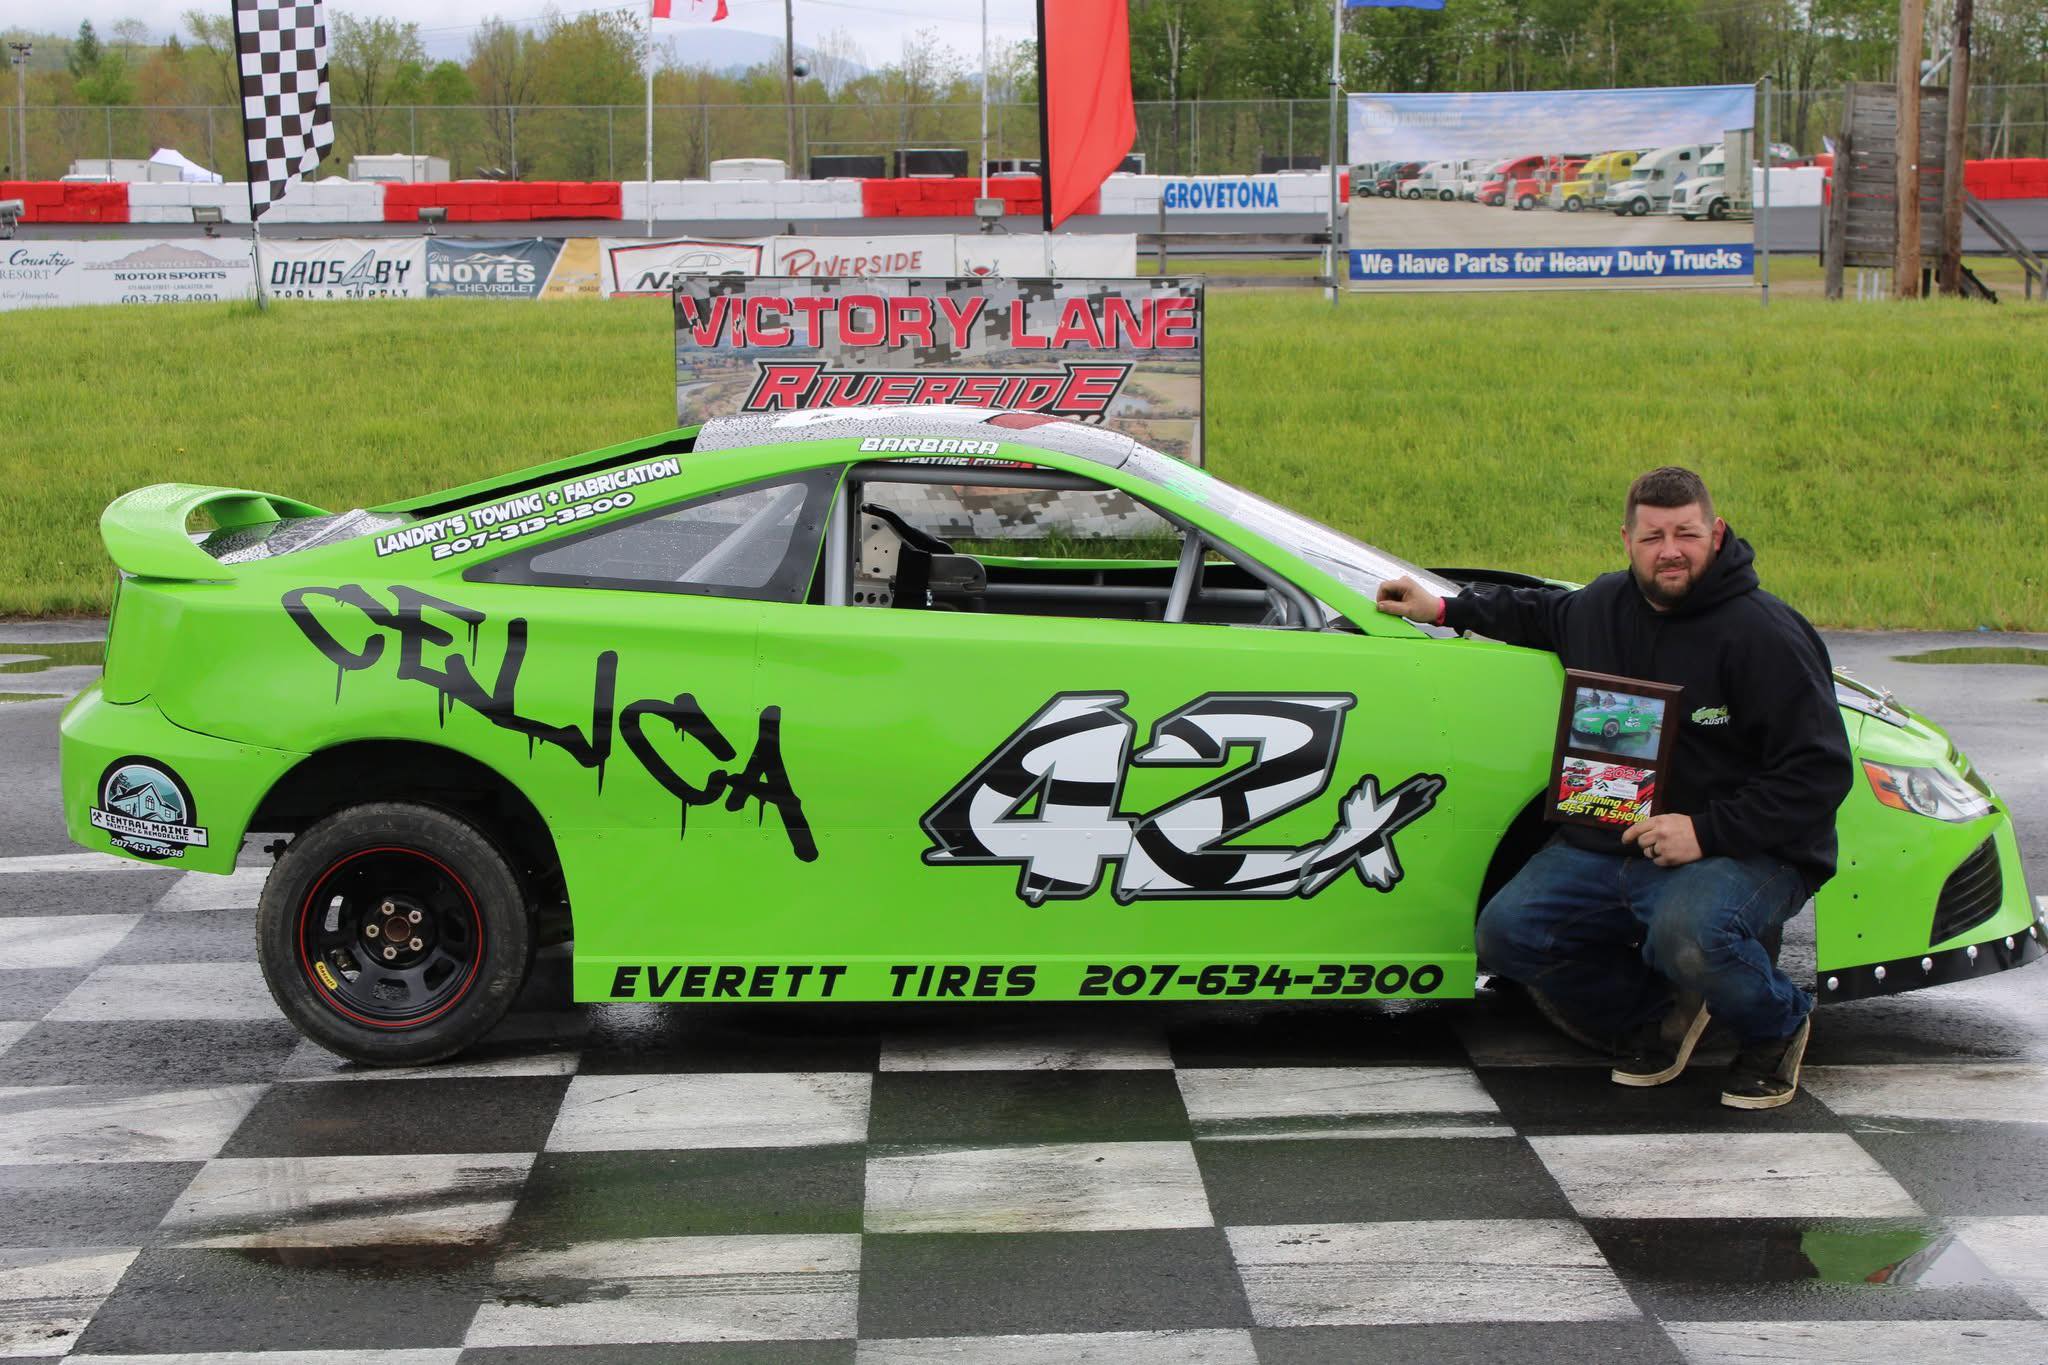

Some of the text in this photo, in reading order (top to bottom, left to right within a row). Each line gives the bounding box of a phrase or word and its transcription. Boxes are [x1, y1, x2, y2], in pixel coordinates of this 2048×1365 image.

[1164, 182, 1279, 208] GROVETONA
[9, 249, 75, 275] Country
[781, 249, 923, 276] RIVERSIDE
[1360, 249, 1742, 276] We Have Parts for Heavy Duty Trucks
[0, 269, 50, 280] RESORT
[114, 271, 227, 281] MOTORSPORTS
[429, 263, 536, 283] NOYES
[274, 290, 314, 298] TOOL
[456, 283, 536, 293] CHEVROLET
[679, 295, 1198, 350] VICTORY LANE
[743, 359, 1136, 414] RIVERSIDE
[860, 437, 999, 455] BARBARA
[375, 513, 468, 557] LANDRY'S
[470, 492, 544, 530] TOWING
[562, 457, 682, 503] FABRICATION
[431, 492, 635, 561] 207-313-3200
[281, 584, 819, 863] CELICA
[1603, 766, 1646, 781] 2025
[1569, 790, 1622, 809] Lightning
[1560, 802, 1649, 822] BEST IN SHOW
[105, 814, 190, 836] CENTRAL MAINE
[106, 823, 137, 834] PAINTING
[143, 830, 189, 841] REMODELING
[111, 837, 184, 858] 207-431-3038
[610, 964, 1444, 998] EVERETT TIRES 207-634-3300
